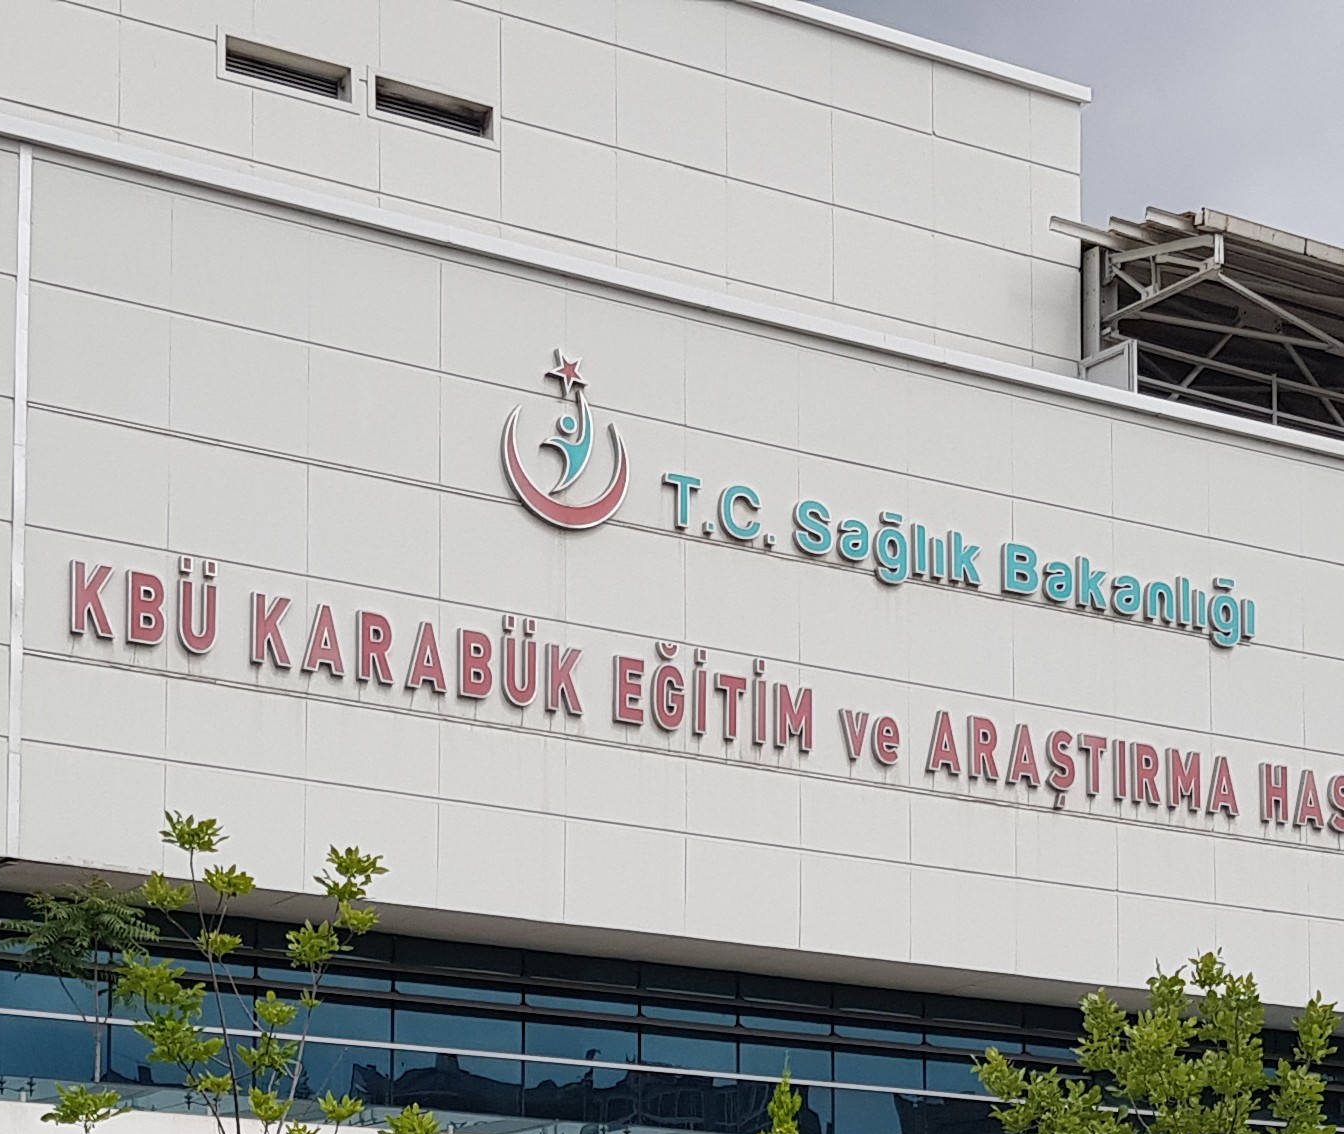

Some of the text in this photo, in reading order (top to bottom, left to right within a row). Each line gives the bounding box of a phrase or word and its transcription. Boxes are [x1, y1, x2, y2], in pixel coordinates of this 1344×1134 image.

[663, 472, 1256, 648] T.C. Sağlık Bakanlığı
[69, 556, 219, 654] KBÜ
[250, 591, 584, 716] KARABÜK
[611, 641, 815, 752] EĞİTİM
[839, 708, 901, 766] ve
[927, 710, 1240, 818] ARAŞTIRMA
